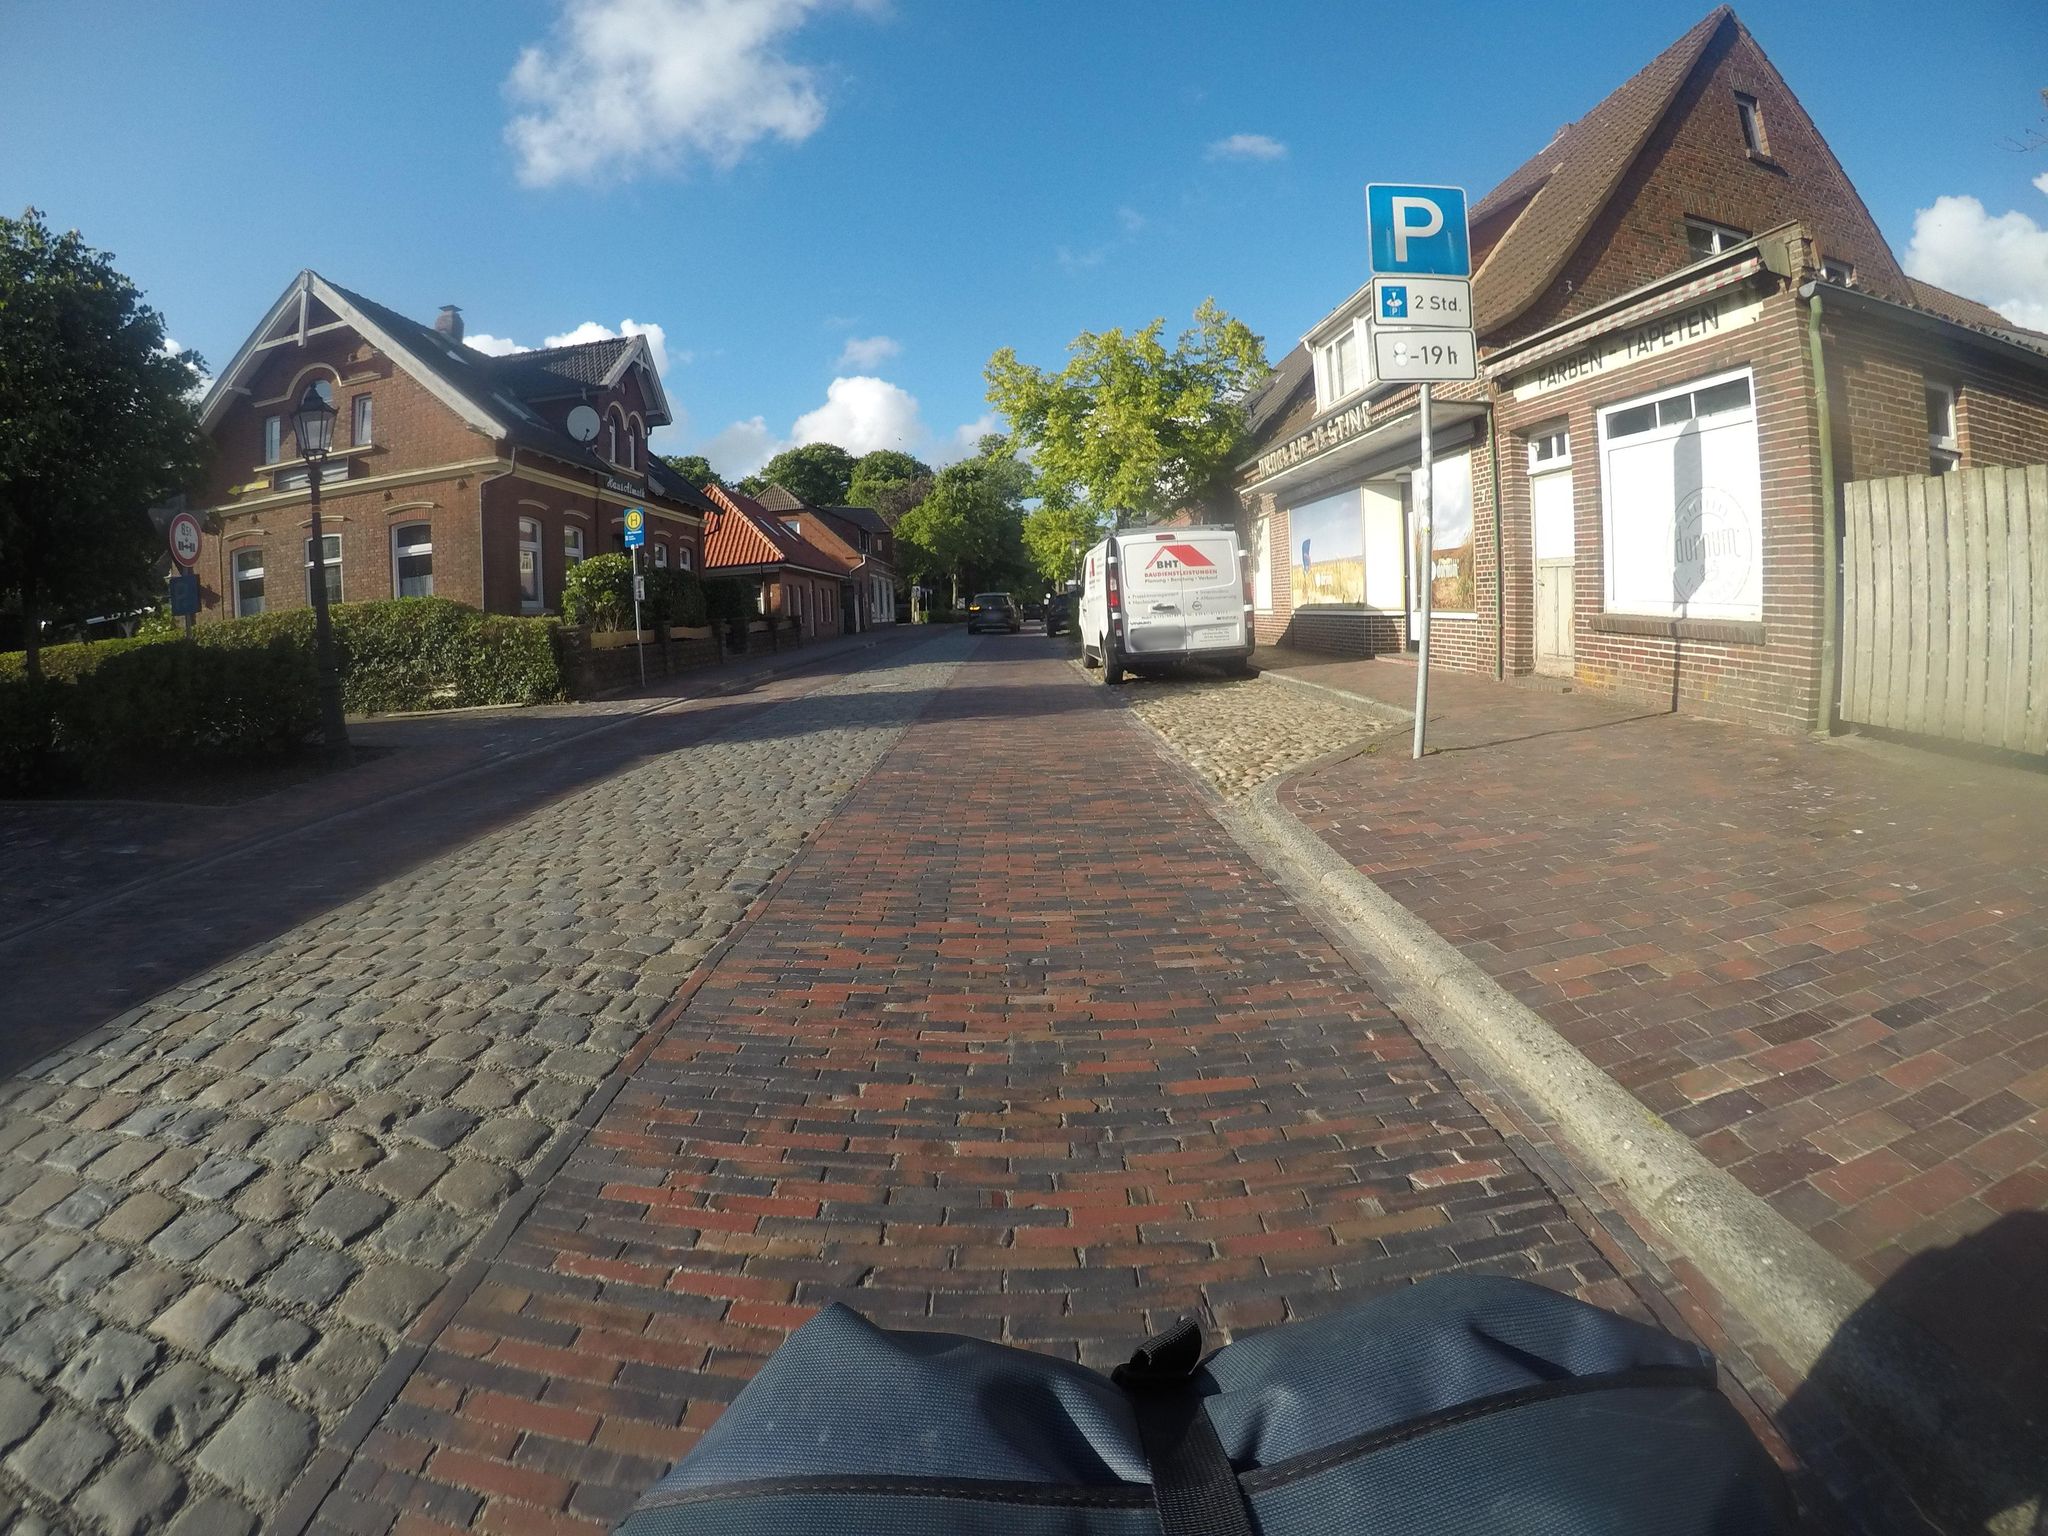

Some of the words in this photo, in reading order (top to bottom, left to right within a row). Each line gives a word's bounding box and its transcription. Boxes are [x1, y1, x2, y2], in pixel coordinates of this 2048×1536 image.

[1391, 196, 1444, 262] P
[1414, 295, 1424, 310] 2
[1430, 295, 1462, 313] Std.
[1538, 350, 1603, 390] FARBEN
[1621, 304, 1720, 359] TAPETEN
[630, 514, 638, 526] H
[1156, 560, 1178, 569] BHT
